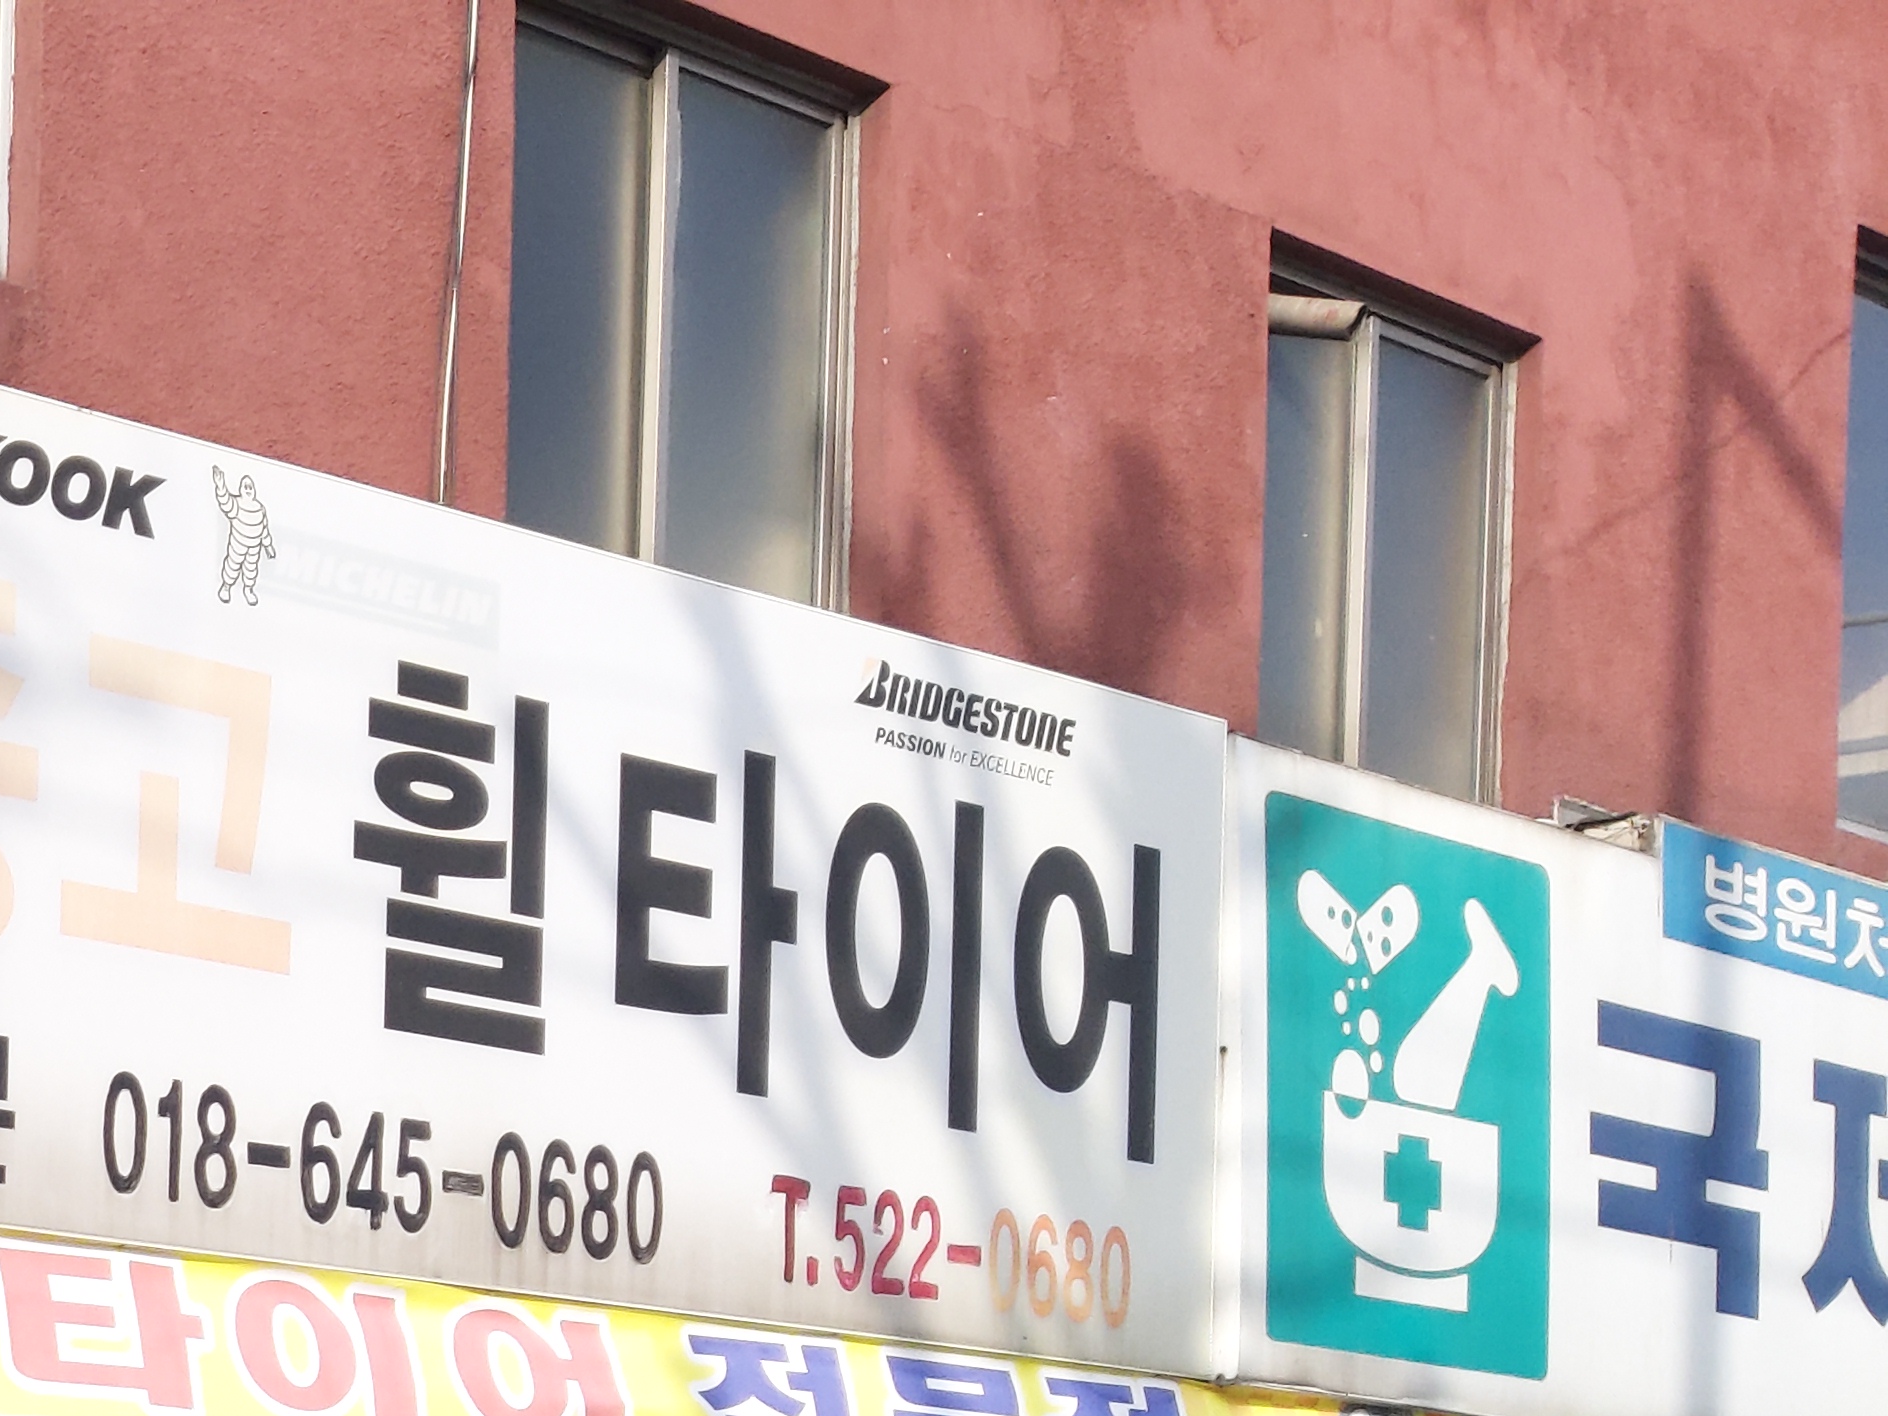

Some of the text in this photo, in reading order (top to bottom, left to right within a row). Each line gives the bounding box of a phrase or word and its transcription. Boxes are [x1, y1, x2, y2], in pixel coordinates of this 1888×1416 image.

[853, 659, 1076, 757] BRIDGESTONE
[875, 727, 947, 759] PASSION
[969, 750, 1054, 786] EXCELLENCE
[354, 659, 1161, 1165] 휠타이어
[103, 1068, 664, 1266] 018-645-0680
[771, 1173, 1131, 1330] T.522-0680
